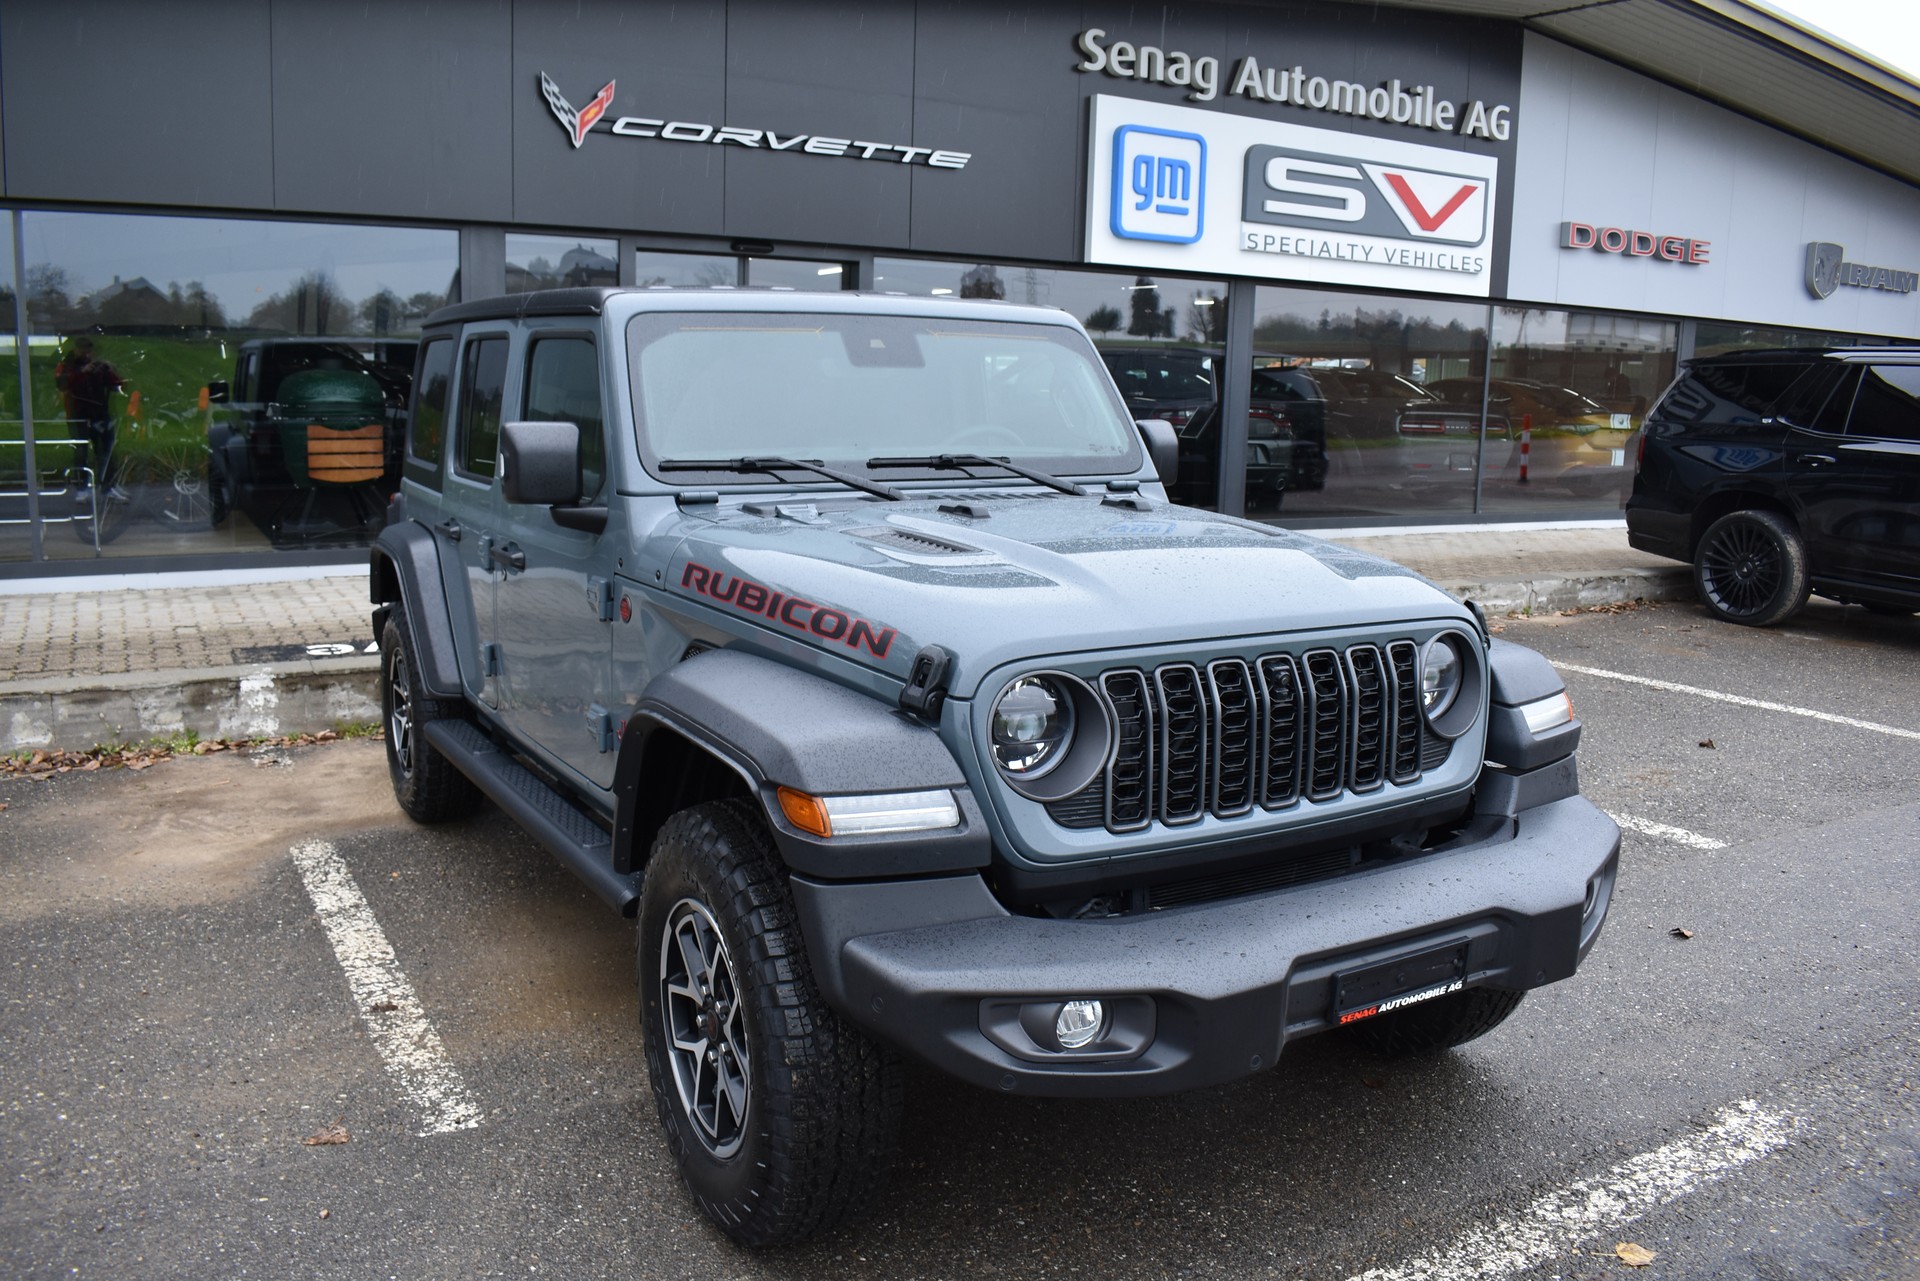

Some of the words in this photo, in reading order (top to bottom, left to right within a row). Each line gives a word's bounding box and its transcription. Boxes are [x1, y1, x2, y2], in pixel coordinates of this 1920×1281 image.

[1078, 28, 1219, 101] Senag
[1230, 56, 1455, 131] Automobile
[1460, 101, 1511, 141] AG
[612, 117, 972, 169] CORVETTE
[1132, 154, 1191, 212] gm
[1264, 157, 1479, 232] SV
[1247, 233, 1374, 261] SPECIALTY
[1384, 247, 1484, 273] VEHICLES
[1561, 221, 1712, 265] DODGE
[1845, 263, 1919, 293] RAM
[681, 561, 897, 660] RUBICON
[1340, 1006, 1377, 1024] SENAG
[1379, 986, 1447, 1013] AUTOMOBILE
[1447, 981, 1462, 993] AG
